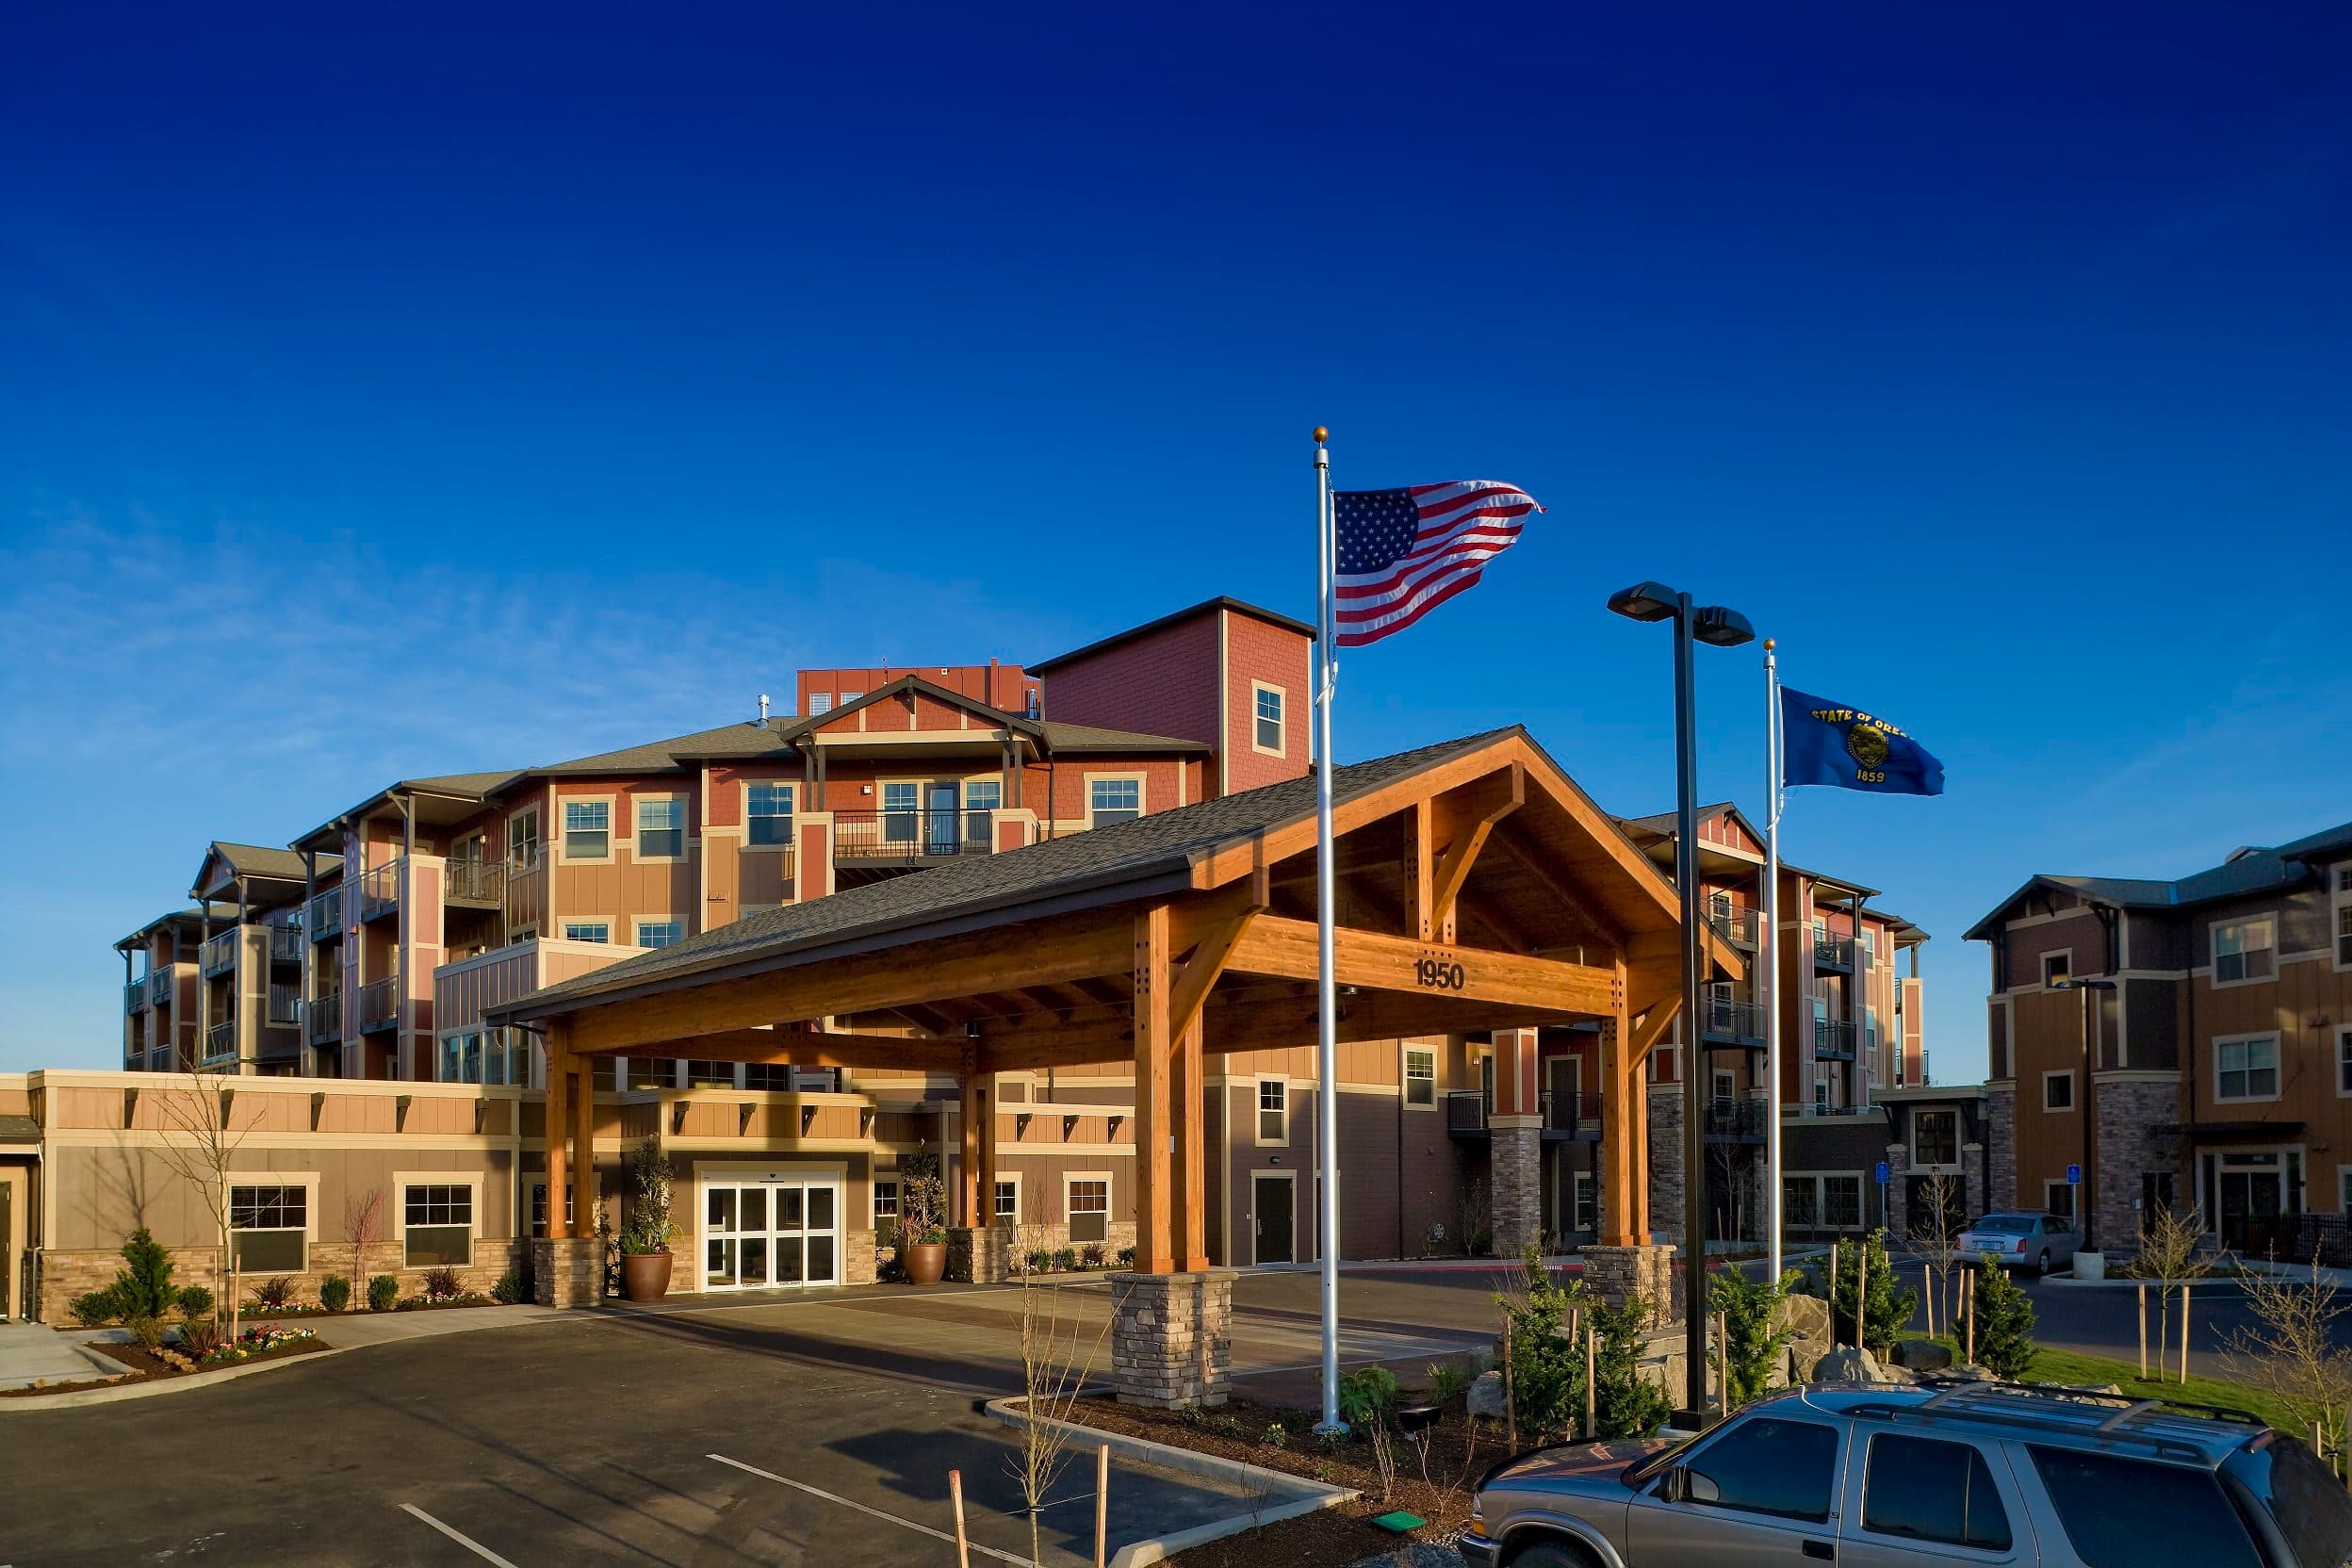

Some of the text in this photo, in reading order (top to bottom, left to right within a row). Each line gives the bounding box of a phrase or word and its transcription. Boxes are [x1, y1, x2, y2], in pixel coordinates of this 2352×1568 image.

[1811, 710, 1853, 723] STATE
[1856, 712, 1872, 722] OF
[1856, 769, 1885, 782] 1859
[1413, 958, 1464, 990] 1950
